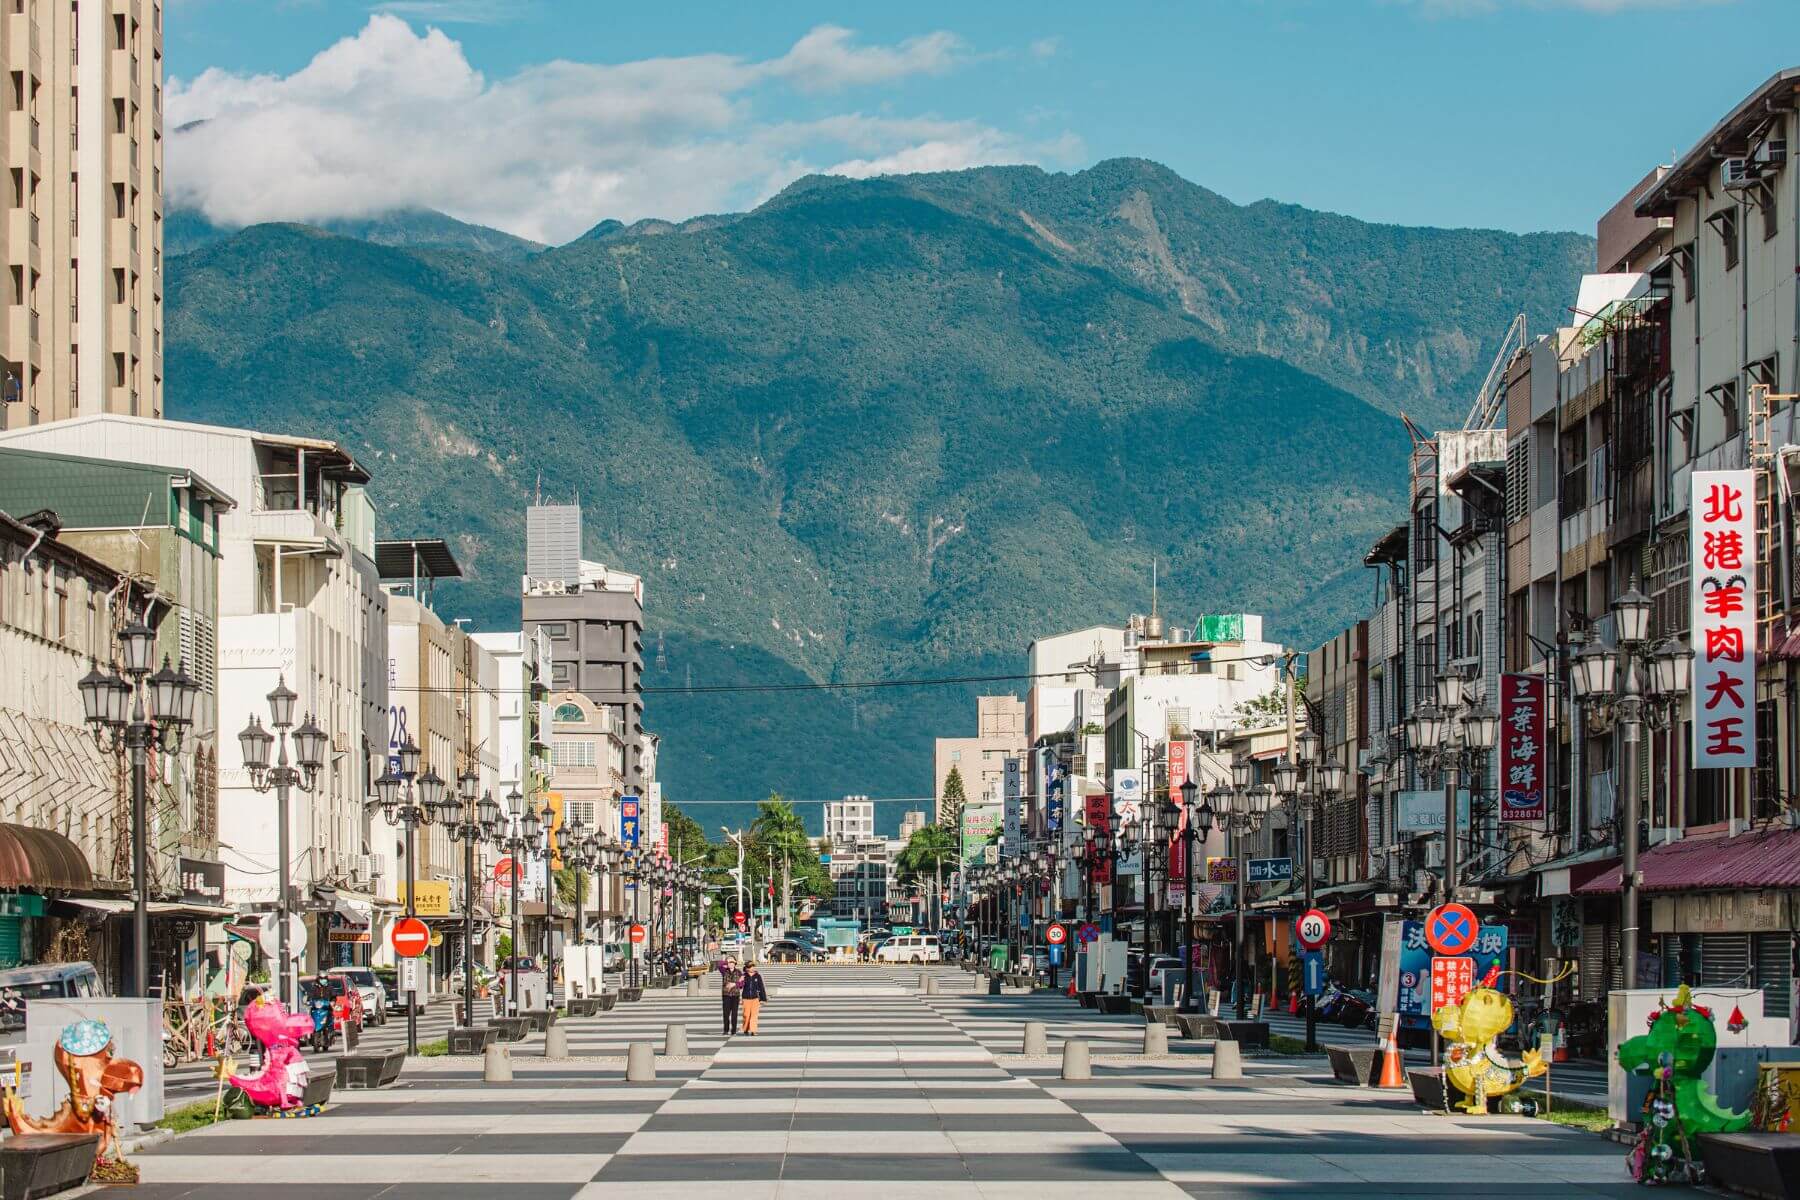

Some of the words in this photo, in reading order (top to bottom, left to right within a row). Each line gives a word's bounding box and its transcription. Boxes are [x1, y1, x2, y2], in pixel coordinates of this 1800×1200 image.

[1703, 485, 1745, 755] 北港羊肉大王
[1508, 680, 1538, 789] 三葉海鮮
[1304, 922, 1321, 937] 30
